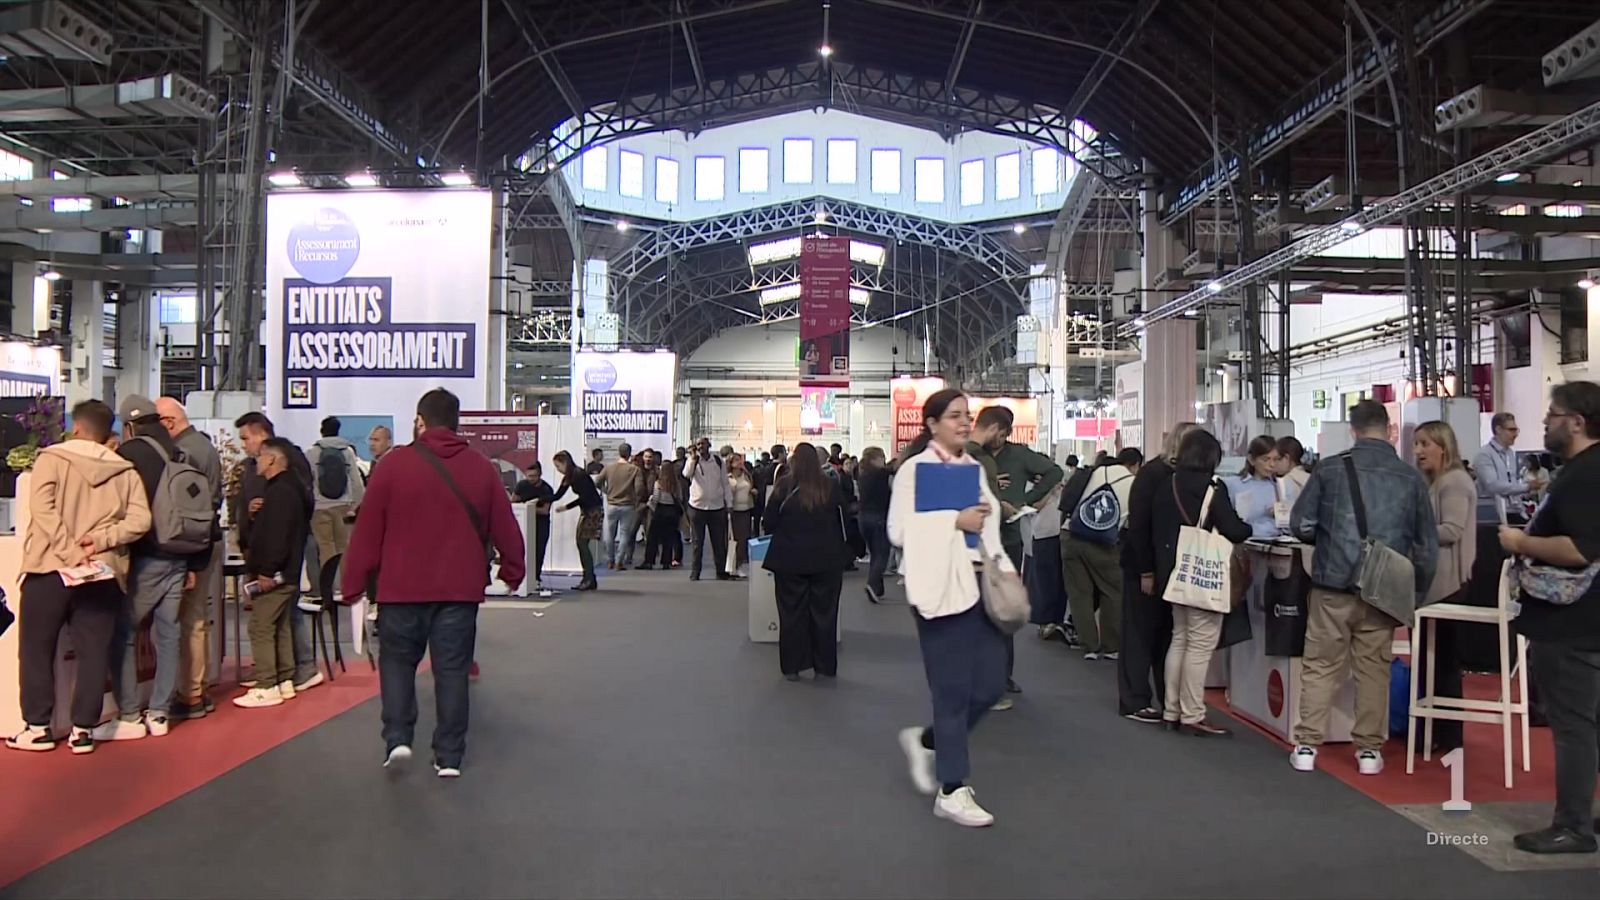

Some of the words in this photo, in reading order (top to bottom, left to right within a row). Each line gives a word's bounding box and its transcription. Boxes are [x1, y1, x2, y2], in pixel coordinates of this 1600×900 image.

[288, 286, 383, 325] ENTITATS
[287, 332, 468, 370] ASSESSORAMENT
[585, 393, 628, 411] ENTITATS
[585, 413, 665, 431] ASSESSORAMENT
